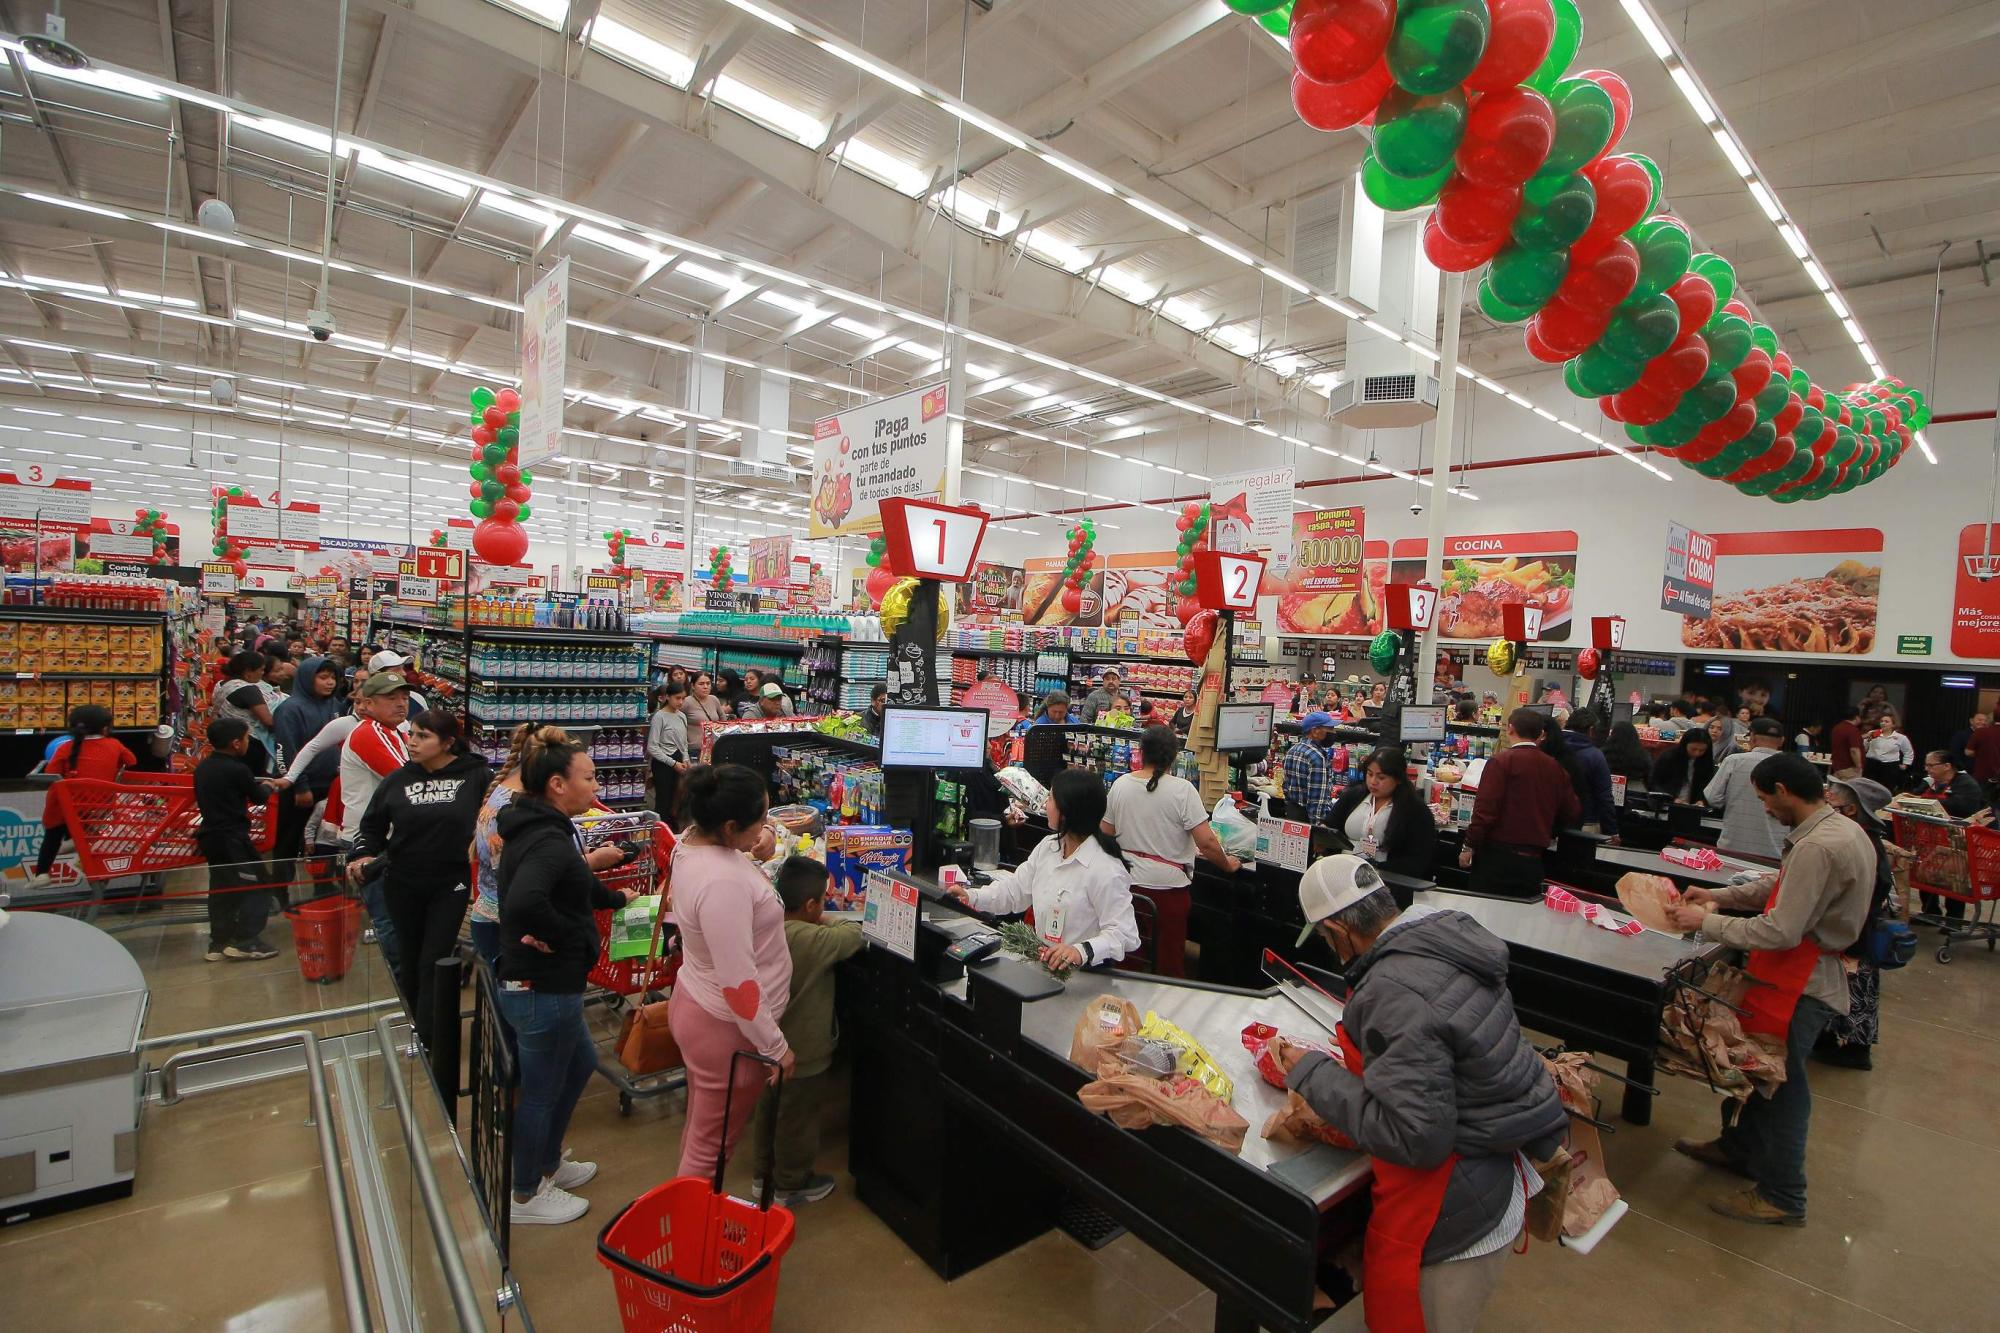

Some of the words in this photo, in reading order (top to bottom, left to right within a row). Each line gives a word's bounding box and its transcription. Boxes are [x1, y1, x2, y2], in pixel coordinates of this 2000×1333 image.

[874, 416, 909, 438] ¡Paga
[851, 447, 869, 461] con
[872, 442, 888, 456] tus
[890, 432, 927, 455] puntos
[28, 465, 43, 482] 3
[859, 461, 879, 476] parte
[880, 458, 890, 469] de
[856, 477, 866, 488] tu
[868, 467, 916, 485] mandado
[1244, 469, 1293, 490] regalar?
[859, 490, 868, 501] de
[869, 485, 889, 499] todos
[891, 483, 902, 496] los
[903, 479, 923, 495] días!
[30, 523, 55, 531] Mjores
[118, 523, 126, 533] 3
[1308, 521, 1333, 532] raspa,
[1334, 519, 1356, 530] gana
[651, 531, 660, 543] 6
[932, 519, 947, 565] 1
[320, 539, 359, 550] ESCADOS
[394, 547, 401, 555] 5
[1454, 540, 1503, 552] COCINA
[1690, 535, 1712, 561] AUTO
[418, 550, 447, 558] EXTINTOR
[203, 564, 233, 574] OFERTA
[1045, 561, 1069, 569] PANAD
[1688, 557, 1713, 584] COBRO
[589, 577, 618, 588] OFERTA
[1233, 565, 1248, 600] 2
[402, 587, 427, 596] $42.50
[709, 590, 733, 600] VINOS
[709, 599, 742, 608] LICORES
[759, 600, 778, 608] OFERTA
[1678, 589, 1685, 603] Al
[1695, 594, 1701, 606] de
[1700, 596, 1711, 611] cajas
[1415, 594, 1426, 622] 3
[1958, 607, 1983, 616] Más
[1527, 613, 1535, 635] 4
[1957, 619, 2000, 629] mejore
[1613, 625, 1620, 644] 5
[404, 780, 466, 797] LOONEY
[410, 790, 456, 805] TUNES
[828, 832, 840, 840] 20
[848, 837, 860, 845] 20
[859, 851, 900, 866] Kellogg's
